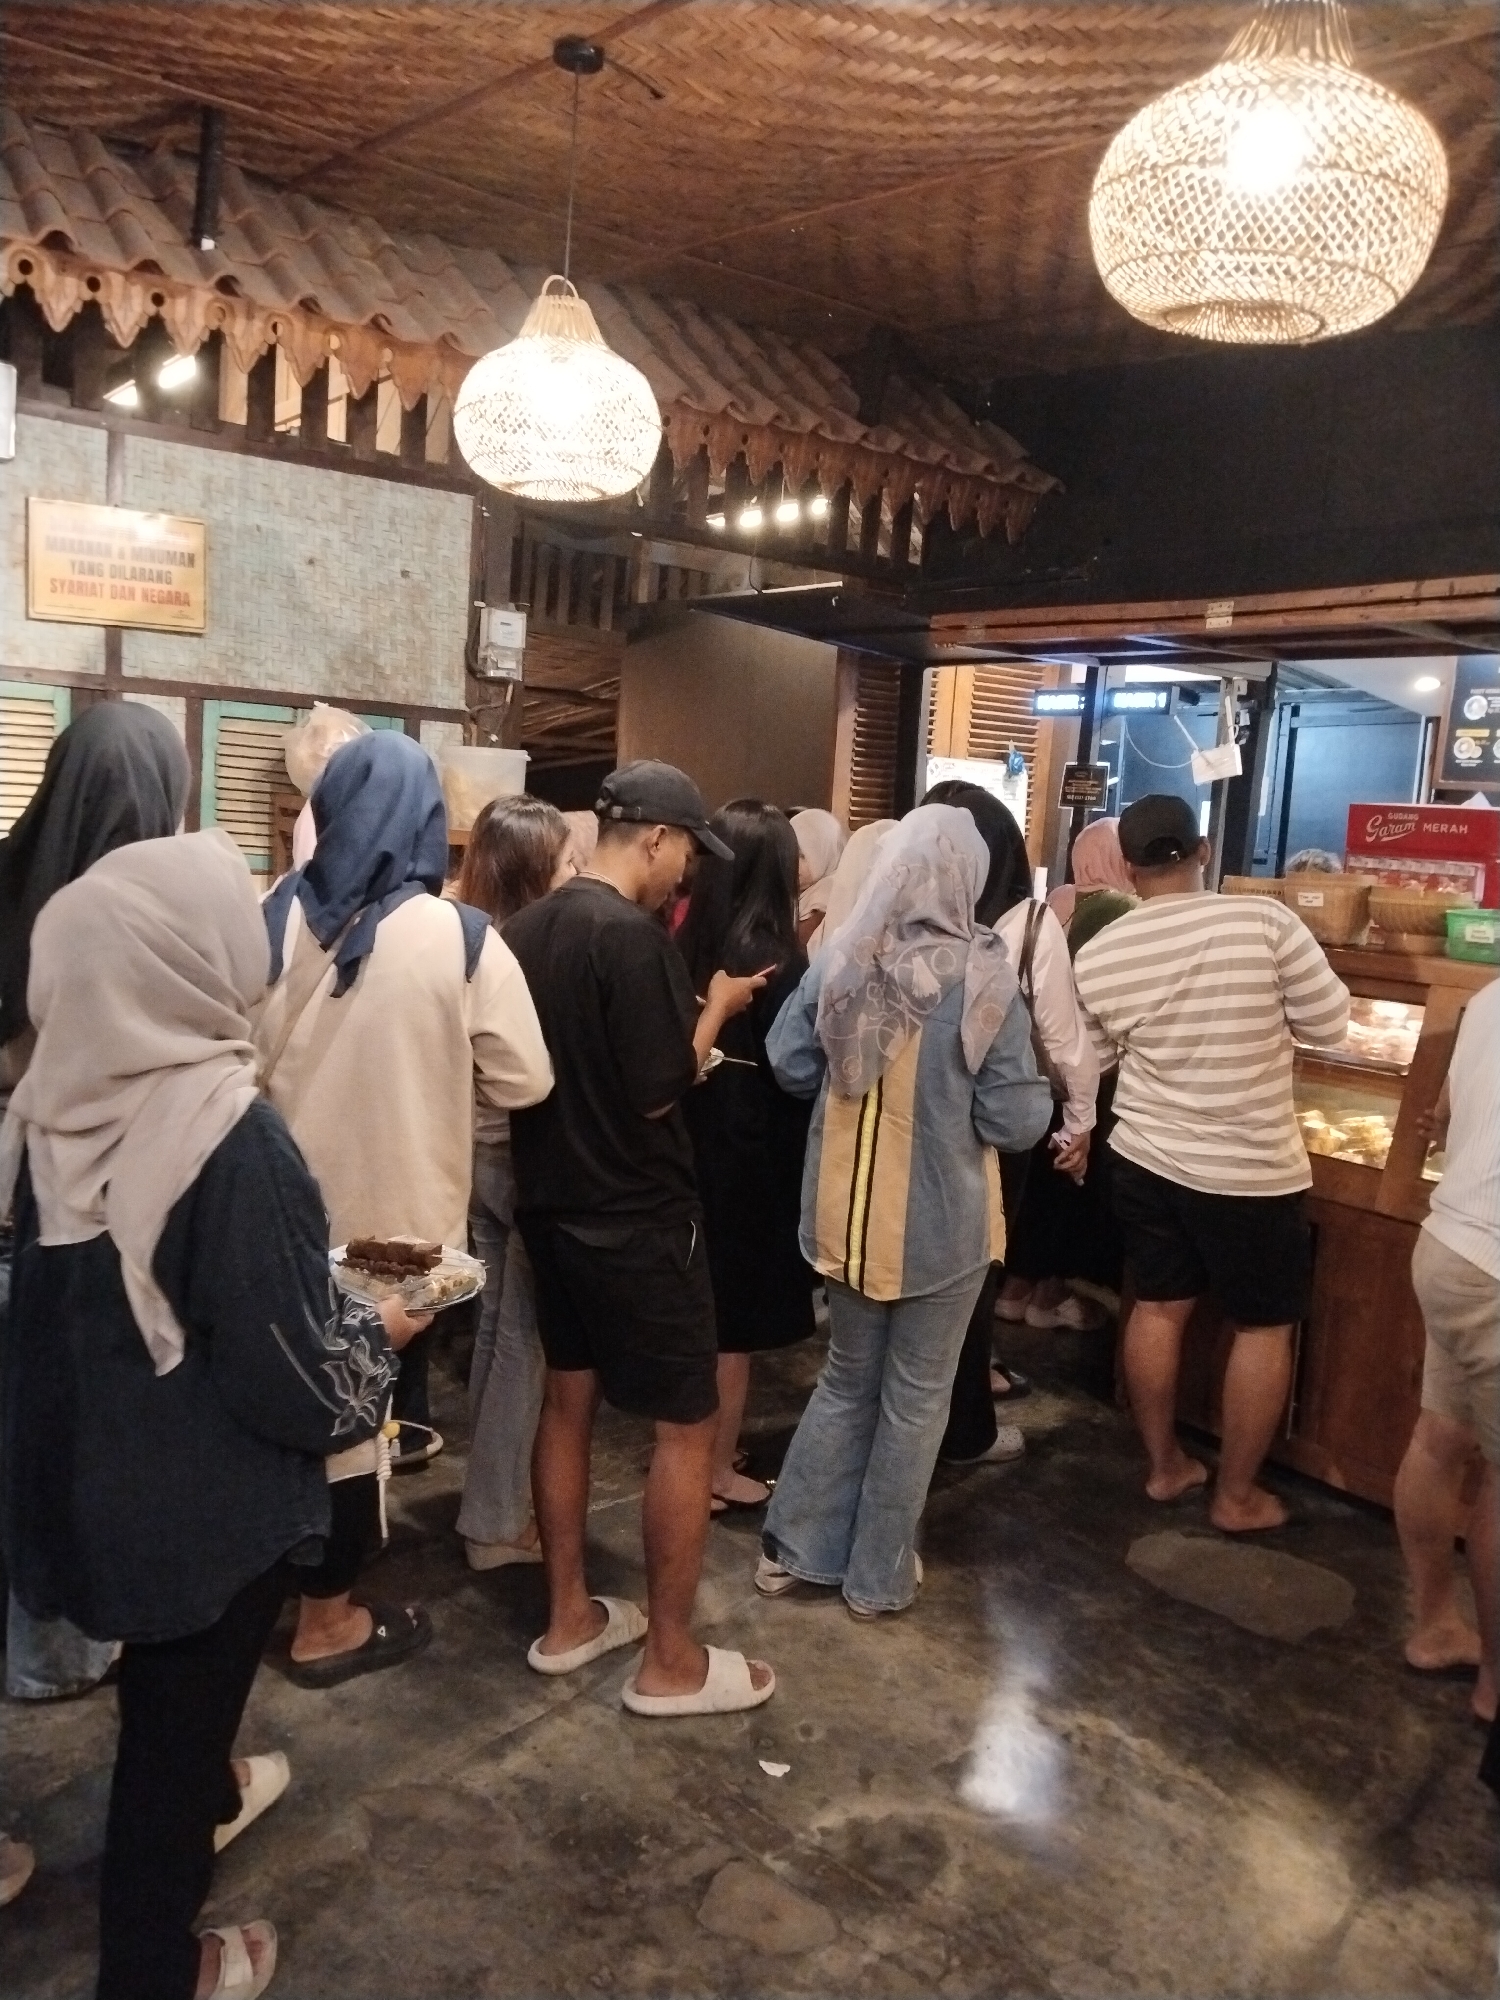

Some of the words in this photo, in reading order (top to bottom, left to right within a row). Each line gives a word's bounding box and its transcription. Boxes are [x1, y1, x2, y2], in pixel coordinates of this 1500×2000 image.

[70, 560, 104, 577] YANG
[109, 564, 173, 585] DILARANG
[49, 578, 105, 598] SYARIAT
[110, 585, 136, 601] DAN
[141, 588, 191, 607] NEGARA
[1365, 815, 1416, 842] Garam
[1423, 823, 1468, 834] MERAH
[1387, 812, 1419, 820] GUDANG
